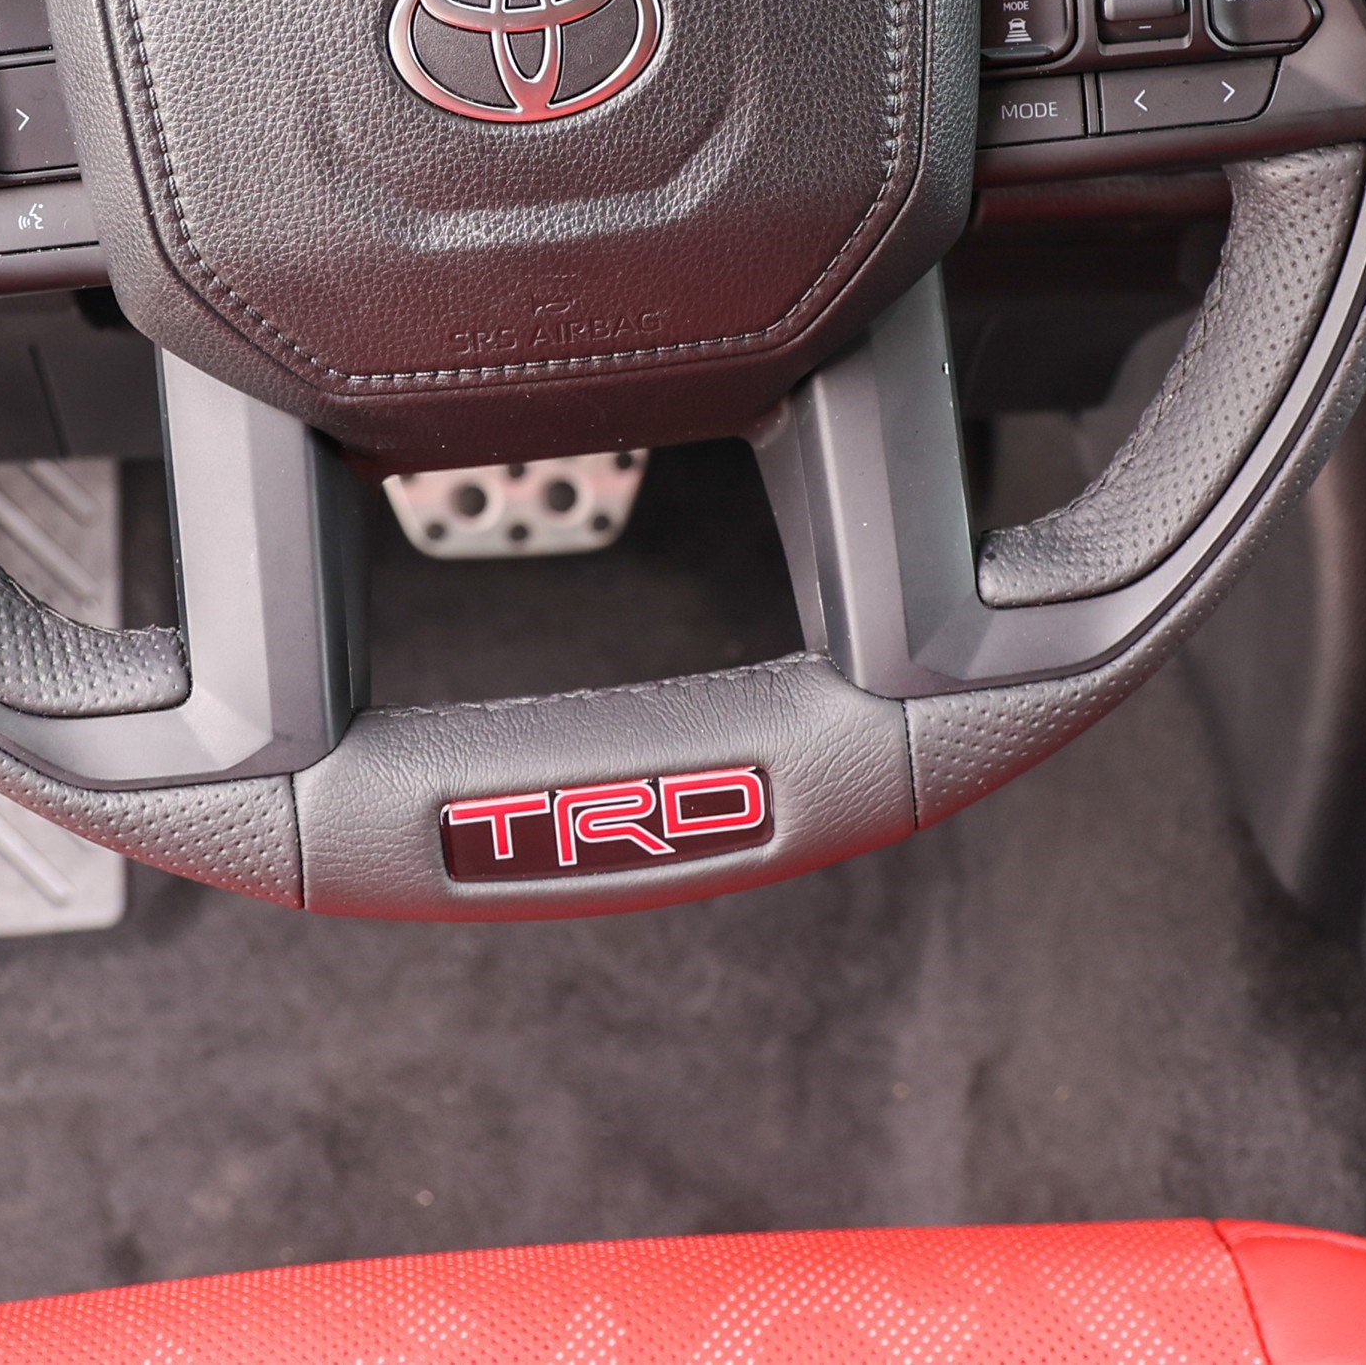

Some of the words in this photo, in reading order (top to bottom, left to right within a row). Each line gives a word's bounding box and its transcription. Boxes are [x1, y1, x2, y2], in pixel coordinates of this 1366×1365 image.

[1003, 1, 1029, 12] MODE
[1001, 101, 1059, 120] MODE
[450, 329, 518, 354] SRS
[533, 309, 666, 349] AIRBAG
[448, 767, 766, 866] TRD
